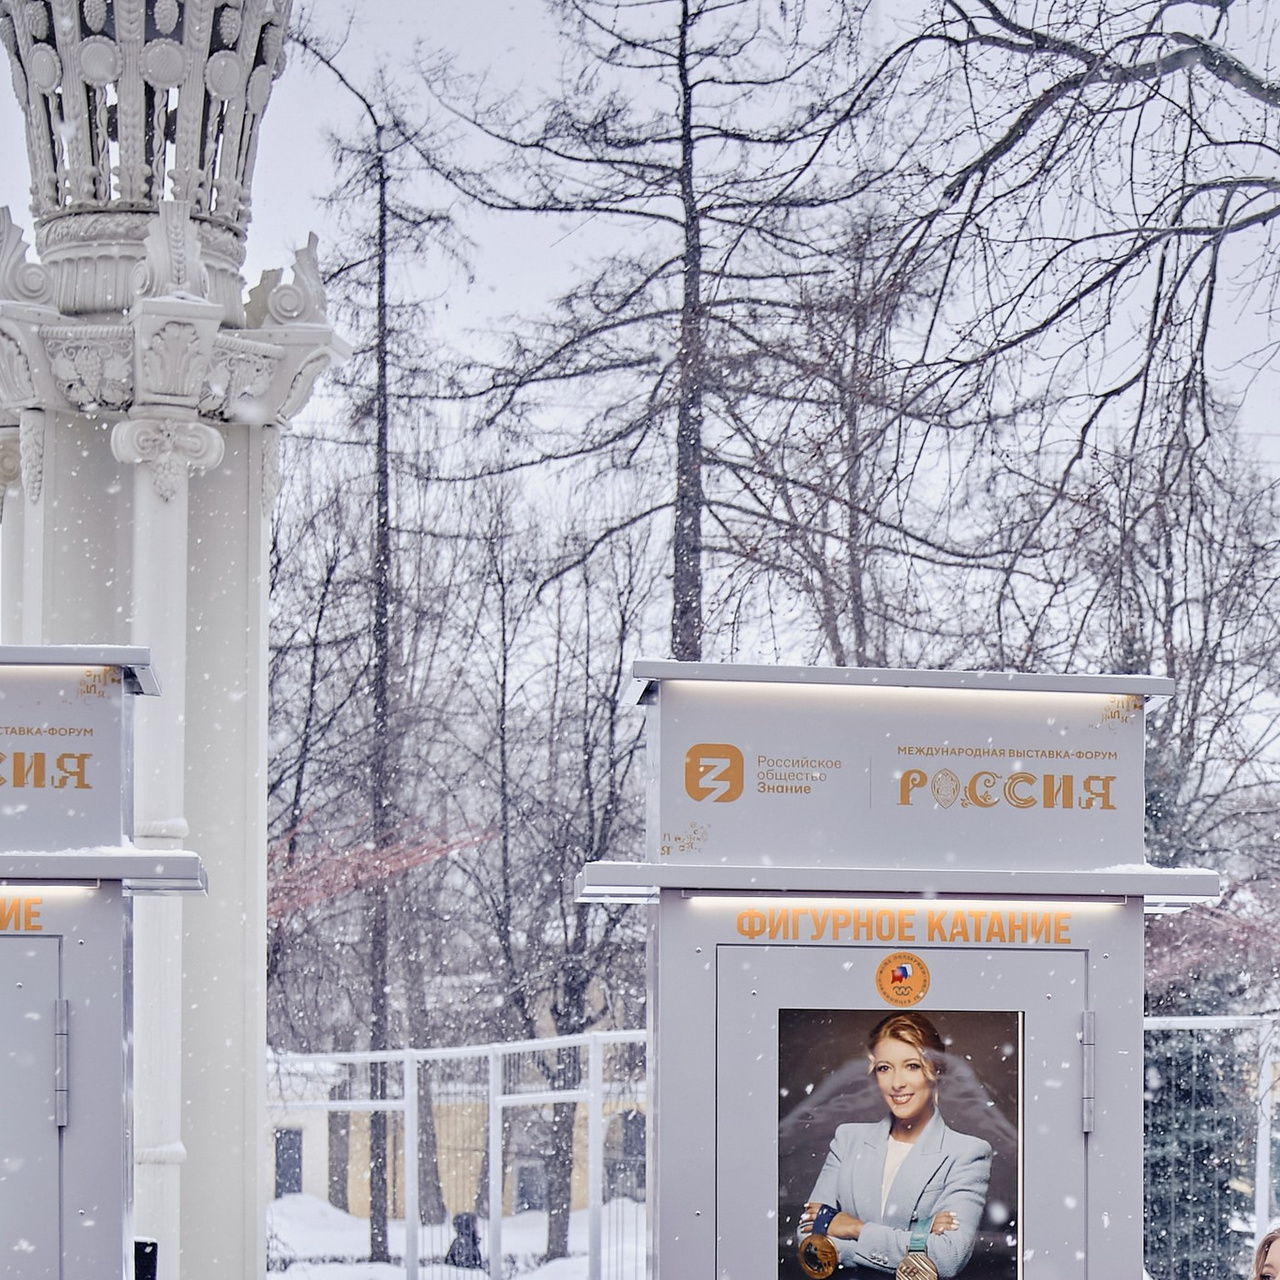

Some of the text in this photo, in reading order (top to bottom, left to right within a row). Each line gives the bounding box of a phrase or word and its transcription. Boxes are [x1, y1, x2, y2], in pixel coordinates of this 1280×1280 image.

[757, 755, 842, 769] Российское
[897, 746, 1118, 761] МЕЖДУНАРОДНАЯ ВЫСТАВКА-ФОРУМ
[0, 752, 93, 789] ИЯ
[757, 782, 812, 794] Знание
[896, 767, 1117, 810] РОССИЯ
[736, 907, 1072, 944] ФИГУРНОЕ КАТАНИЕ
